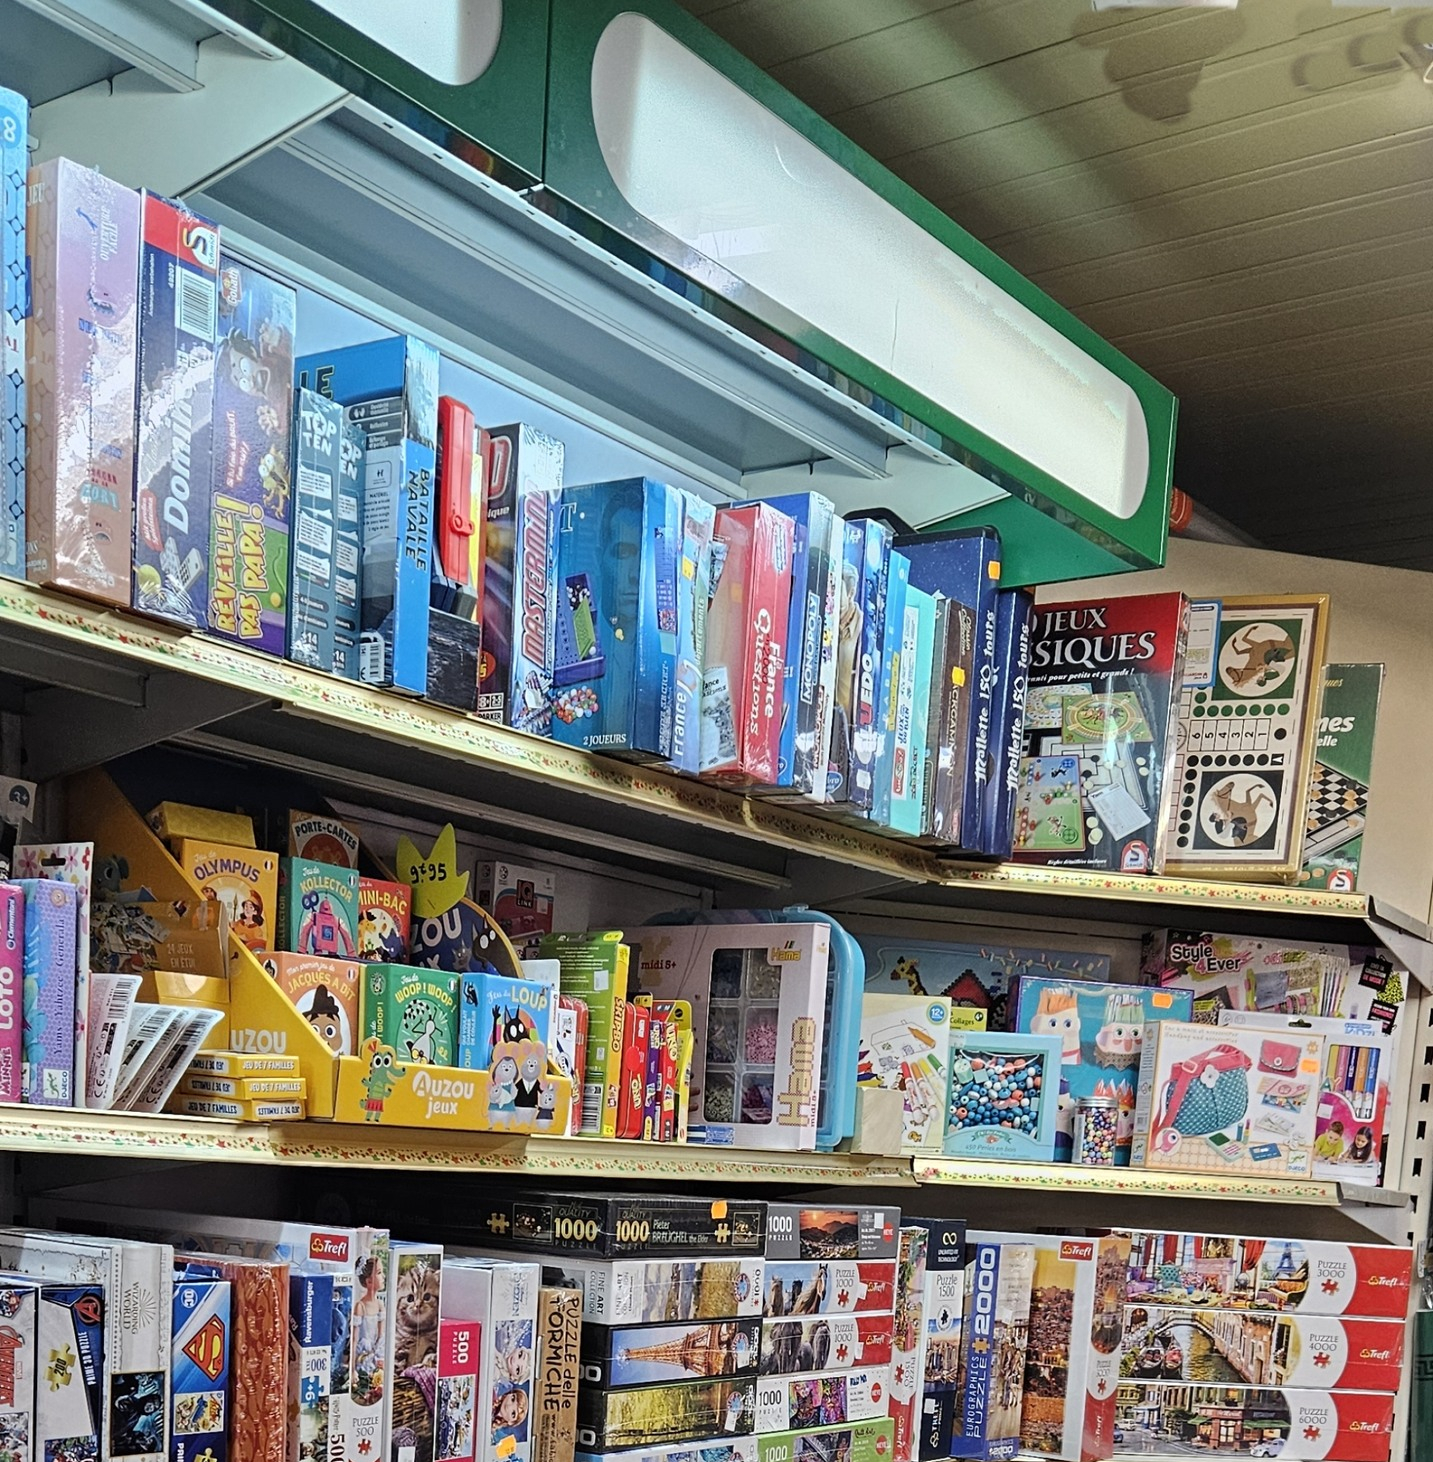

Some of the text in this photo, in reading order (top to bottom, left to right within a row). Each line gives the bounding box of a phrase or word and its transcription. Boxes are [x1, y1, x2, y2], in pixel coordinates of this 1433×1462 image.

[228, 268, 241, 304] Goliath
[300, 411, 338, 440] TOP
[302, 431, 332, 457] TEN
[405, 470, 419, 560] NAVALE
[415, 468, 430, 573] BATAILLE
[240, 593, 262, 640] PAS
[1044, 607, 1108, 636] JEUX
[802, 593, 819, 703] MONOPOLY
[750, 608, 771, 736] Questions
[765, 642, 781, 719] France
[1070, 670, 1091, 685] petits
[974, 608, 994, 785] Mallette 150 tours
[1005, 622, 1029, 792] Mallette 150 tours
[674, 692, 687, 757] France
[591, 732, 627, 746] JOUEURS
[294, 820, 358, 850] PORTE-CARTES
[193, 859, 260, 883] OLYMPUS
[300, 876, 353, 901] KOLLECTOR
[7, 898, 15, 939] Clementoni
[771, 947, 801, 961] Hama
[1171, 943, 1213, 962] Style
[641, 959, 664, 970] midi
[1206, 957, 1241, 973] Ever
[53, 918, 66, 1056] Yams Yahtzee Generala
[288, 971, 330, 994] JACQUES
[1, 966, 14, 1030] LOTO
[395, 983, 455, 1006] WOOP WOOP
[511, 985, 548, 1012] LOUP
[611, 996, 625, 1052] SKIPBO
[949, 1016, 975, 1027] Collages
[231, 1030, 287, 1054] UZOU
[0, 1046, 12, 1096] MINNIE
[267, 1061, 295, 1070] FAMILLES
[777, 1016, 816, 1126] Hama
[60, 1071, 69, 1098] DJECO
[275, 1081, 301, 1092] FAMILLES
[412, 1070, 474, 1099] AUZOU
[214, 1103, 238, 1114] FAMILLES
[426, 1096, 458, 1119] jeux
[558, 1208, 591, 1219] QUALITY
[768, 1216, 793, 1233] 1000
[554, 1218, 598, 1240] 1000
[616, 1219, 650, 1242] 1000
[653, 1220, 671, 1231] Pieter
[324, 1239, 348, 1256] Trefl
[652, 1231, 689, 1244] BREUGHEL
[835, 1269, 856, 1279] PUZZLE
[1317, 1260, 1347, 1271] PUZZLE
[1317, 1269, 1345, 1279] 3000
[835, 1278, 854, 1288] 1000
[936, 1274, 958, 1287] Puzzle
[938, 1286, 955, 1298] 1500
[975, 1248, 995, 1335] 2000
[1378, 1275, 1398, 1287] Trefl
[122, 1287, 132, 1330] WORLD
[131, 1281, 139, 1335] WIZARDING
[304, 1280, 314, 1344] Ravensburger
[834, 1324, 854, 1335] PUZZLE
[834, 1333, 853, 1343] 1000
[1309, 1333, 1339, 1344] PUZZLE
[457, 1331, 469, 1364] 500
[545, 1296, 564, 1412] FORMICHE
[561, 1297, 580, 1410] PUZZLE delle
[1309, 1342, 1337, 1352] 4000
[1370, 1349, 1390, 1360] Trefl
[759, 1391, 782, 1406] 1000
[966, 1356, 980, 1437] EUROGRAPHICS
[974, 1357, 988, 1438] PUZZLE
[352, 1416, 380, 1428] PUZZLE
[1299, 1407, 1328, 1418] PUZZLE
[1299, 1415, 1327, 1425] 6000
[356, 1426, 376, 1438] 500
[1359, 1421, 1379, 1432] Trefl
[764, 1445, 788, 1462] 1000
